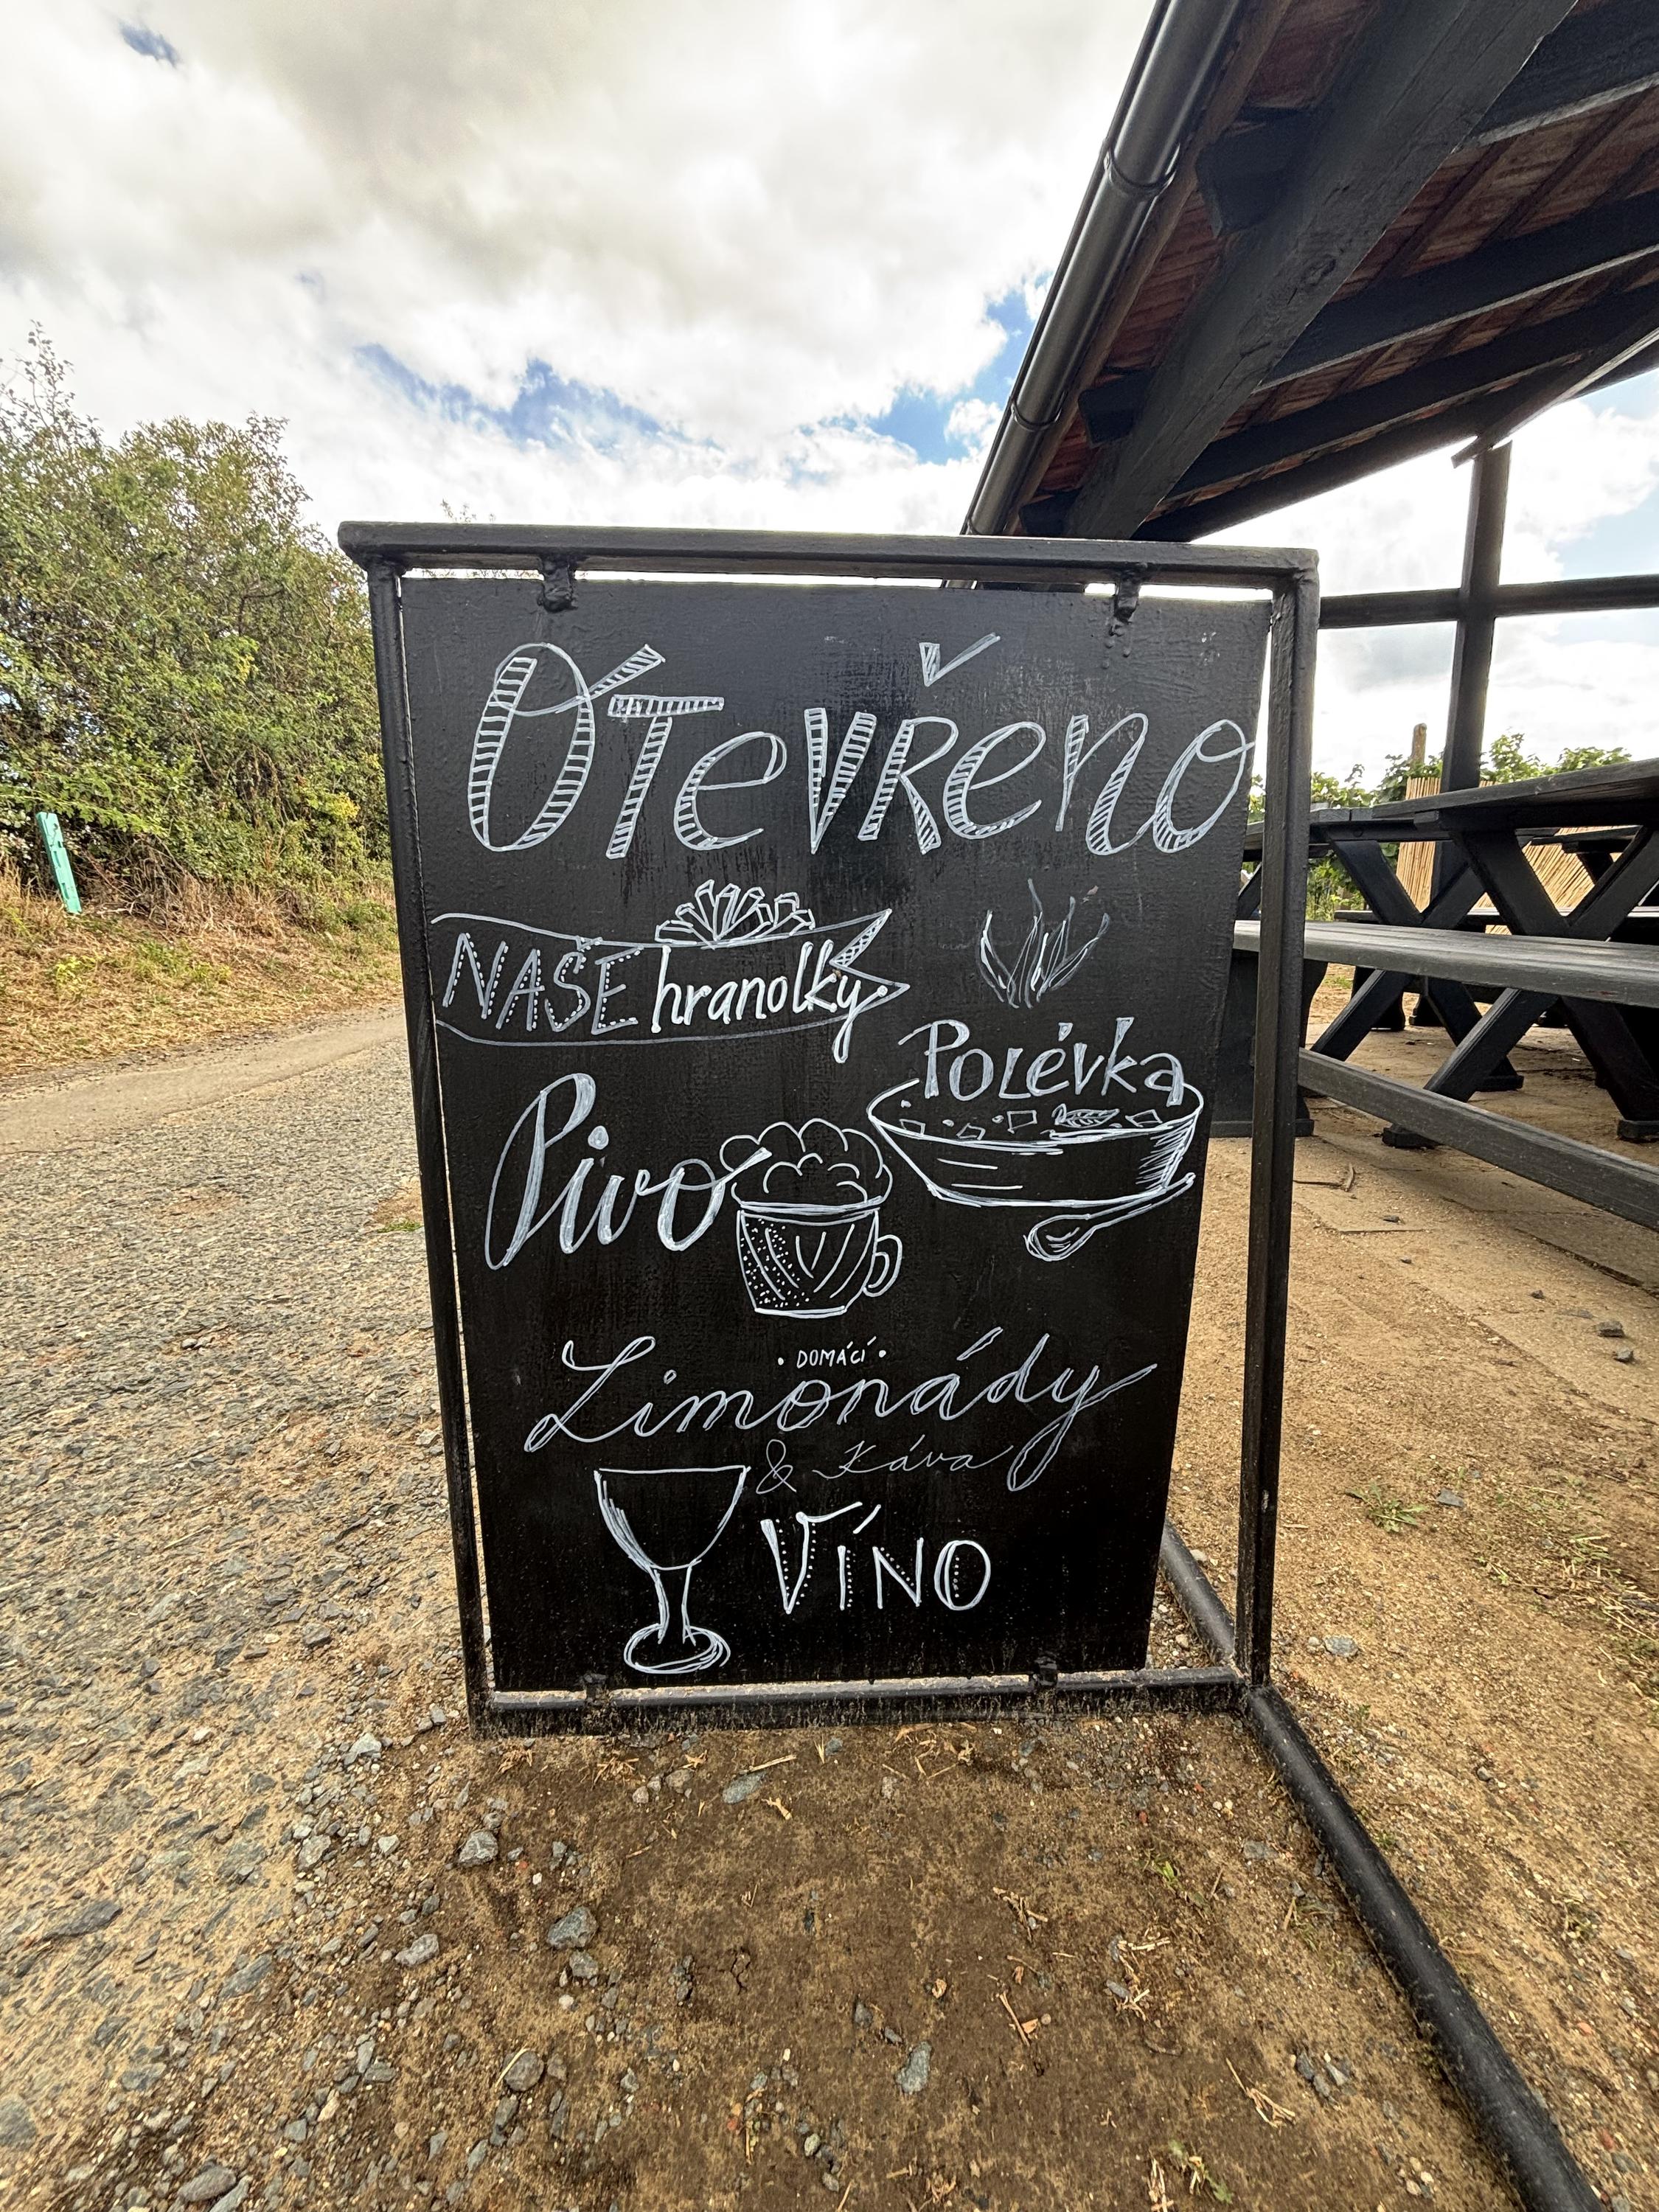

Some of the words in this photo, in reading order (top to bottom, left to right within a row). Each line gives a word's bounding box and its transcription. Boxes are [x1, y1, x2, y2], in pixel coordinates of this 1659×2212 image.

[442, 932, 644, 1034] NAŠE
[651, 940, 888, 1063] hranolky
[484, 1073, 771, 1272] Pivo
[524, 1326, 1158, 1492] Limonády
[756, 1439, 797, 1495] &
